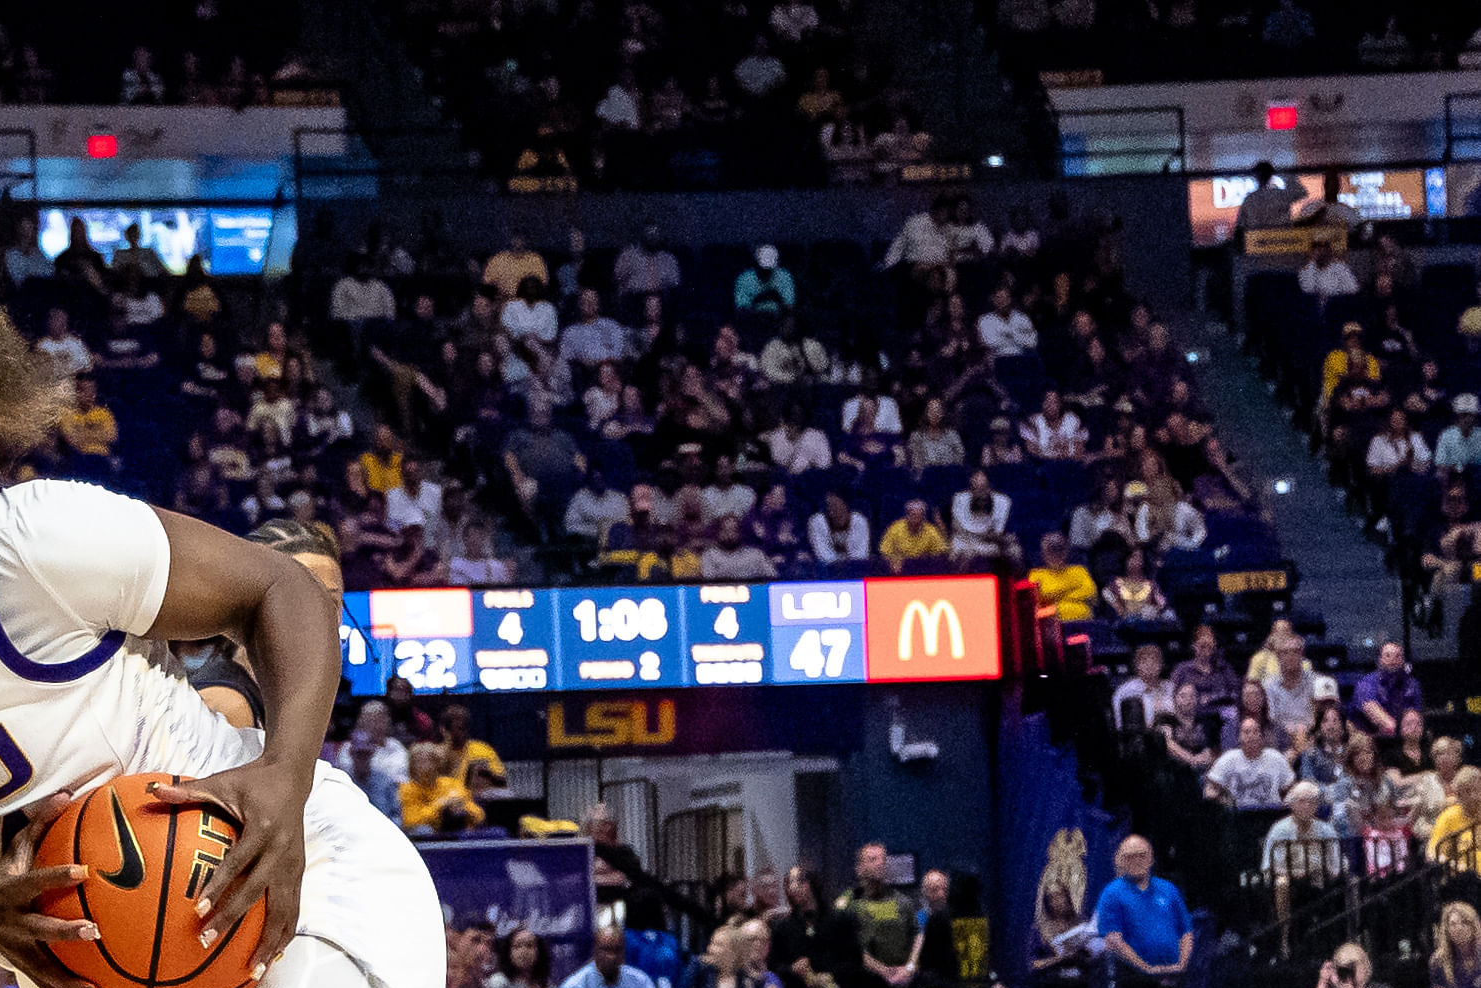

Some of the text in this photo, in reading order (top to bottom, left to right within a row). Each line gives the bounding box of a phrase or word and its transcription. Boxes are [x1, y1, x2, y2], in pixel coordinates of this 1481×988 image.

[498, 612, 524, 646] 4
[713, 606, 740, 640] 4
[394, 639, 458, 689] 22
[638, 650, 662, 681] 2
[789, 628, 852, 679] 47
[548, 699, 676, 747] LSU
